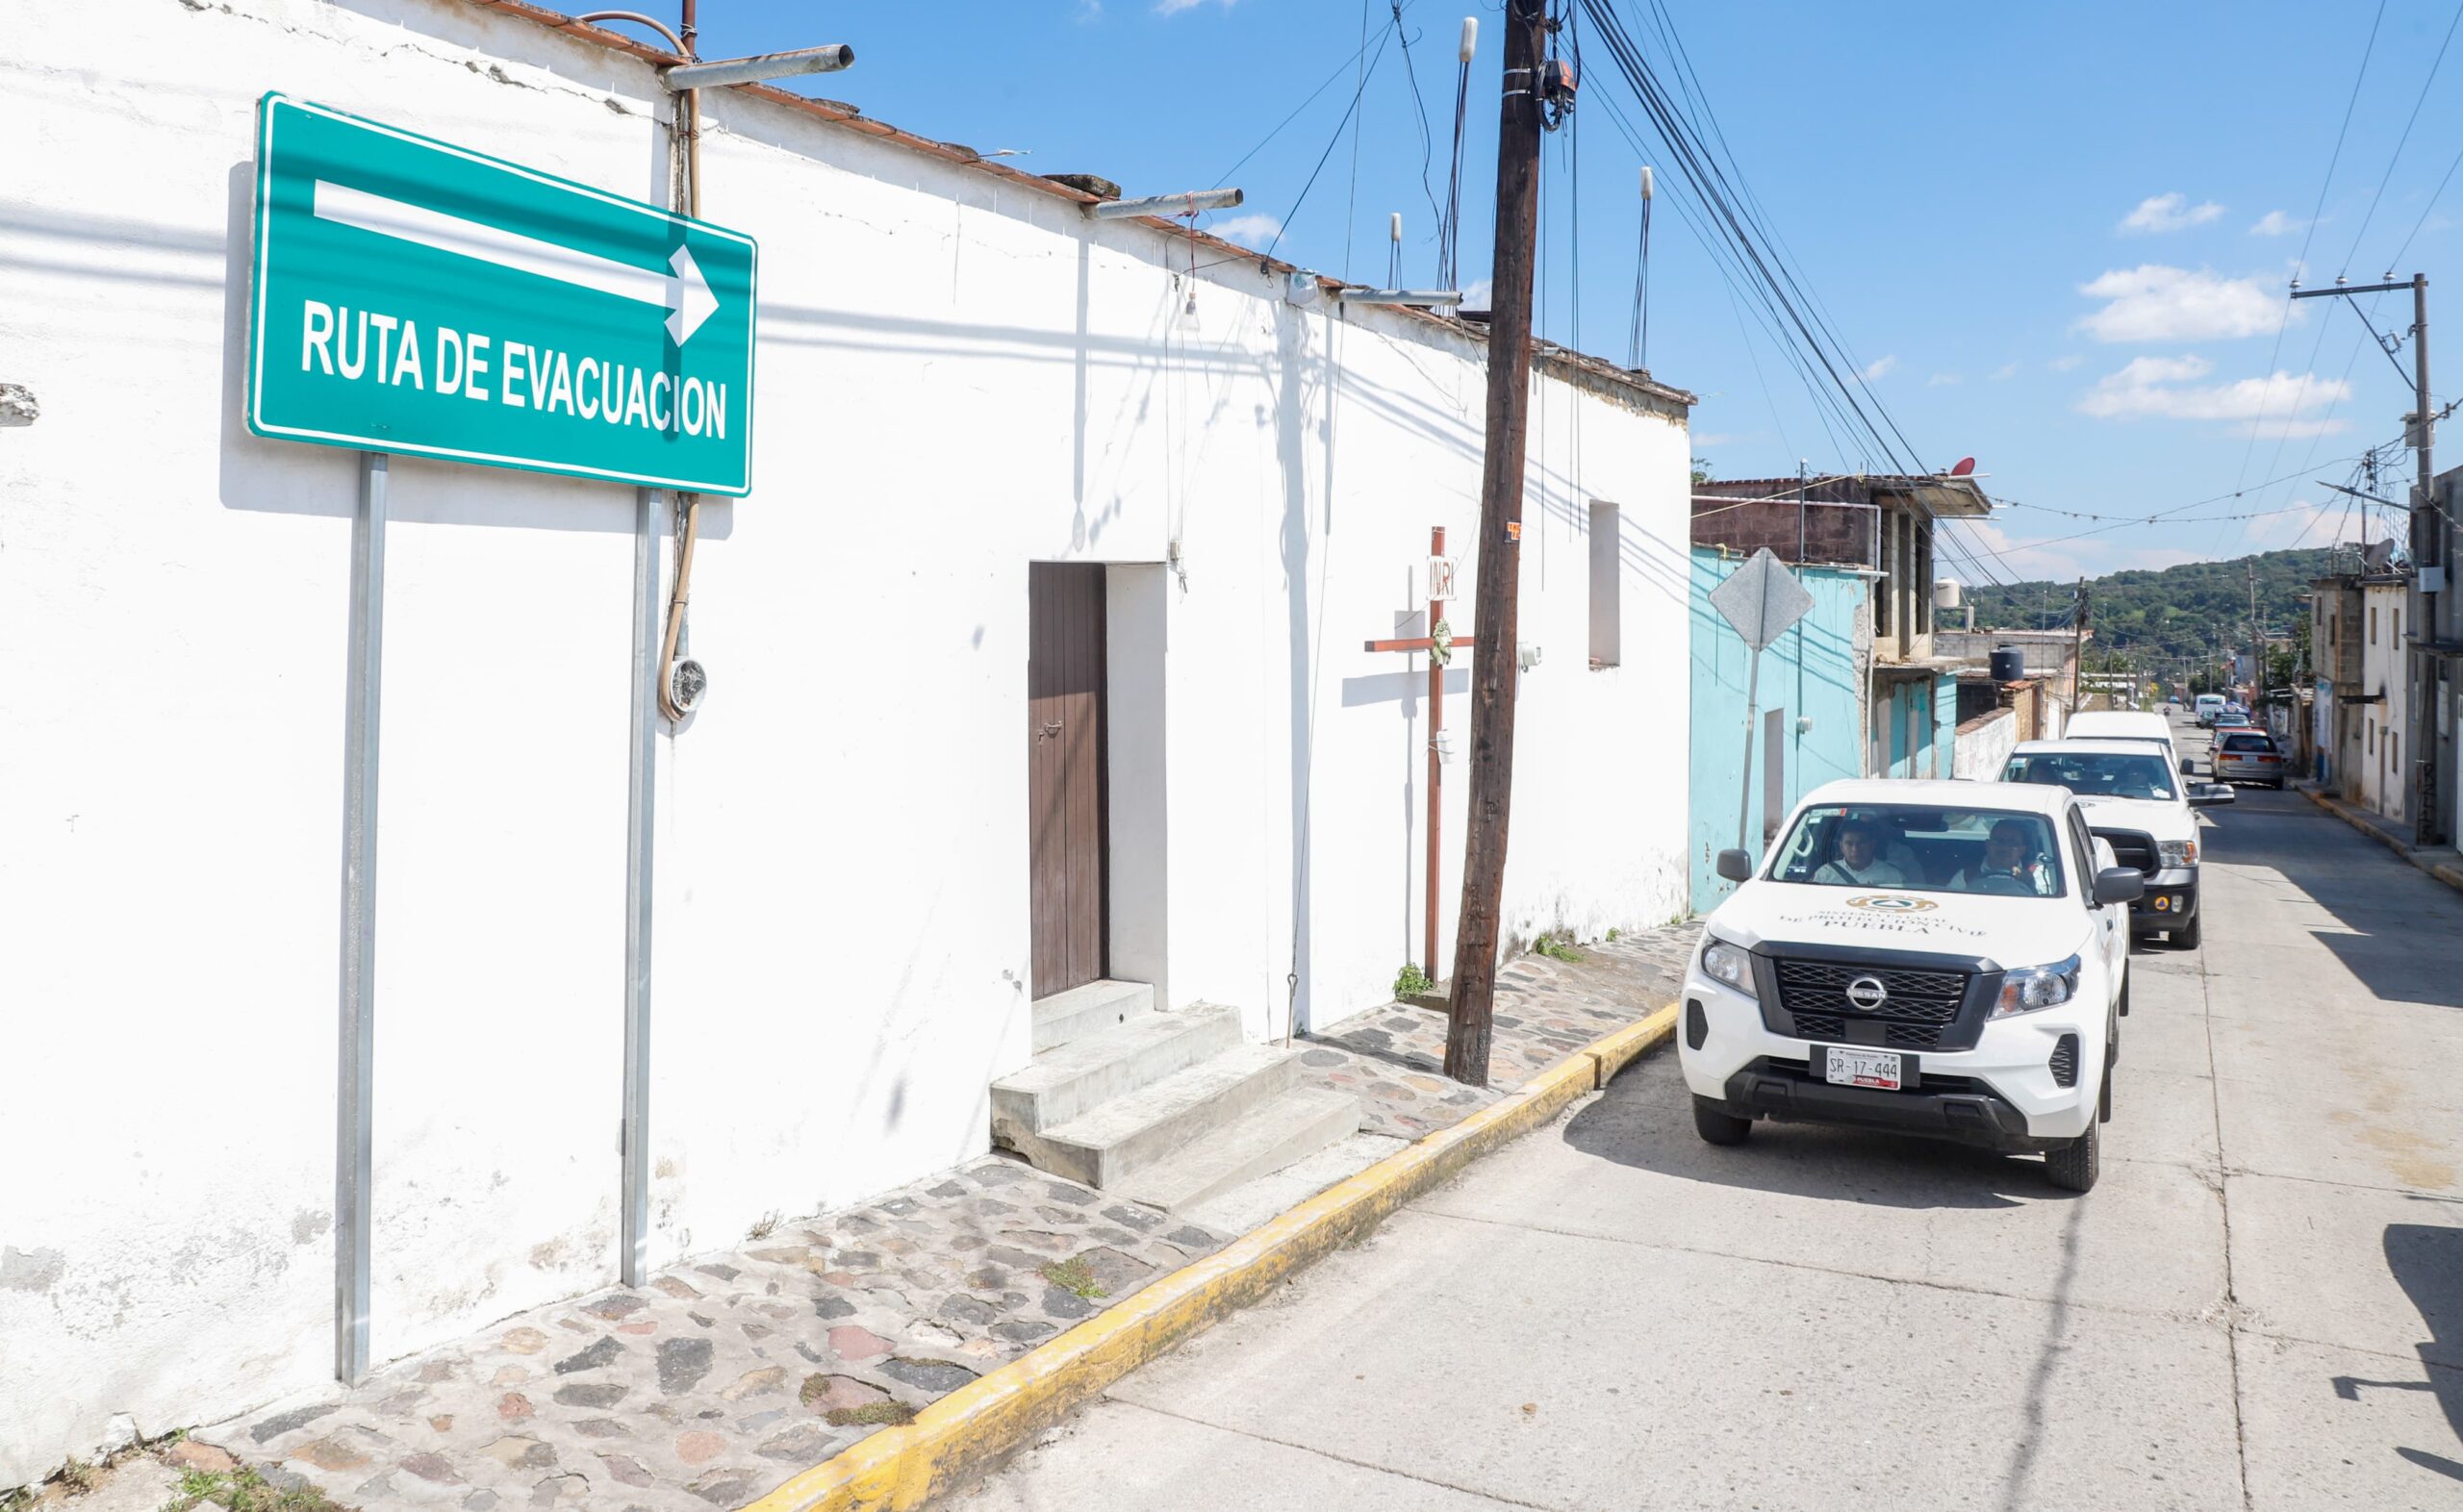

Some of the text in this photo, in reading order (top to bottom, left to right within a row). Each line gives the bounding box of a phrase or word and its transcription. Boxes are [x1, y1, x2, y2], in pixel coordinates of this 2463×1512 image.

[301, 300, 726, 441] RUTA DE EVACUACION
[1430, 561, 1454, 596] INRI
[1823, 920, 1930, 935] PUEBLA
[1846, 988, 1887, 999] NISSAN
[1830, 1058, 1897, 1078] SR-17-444
